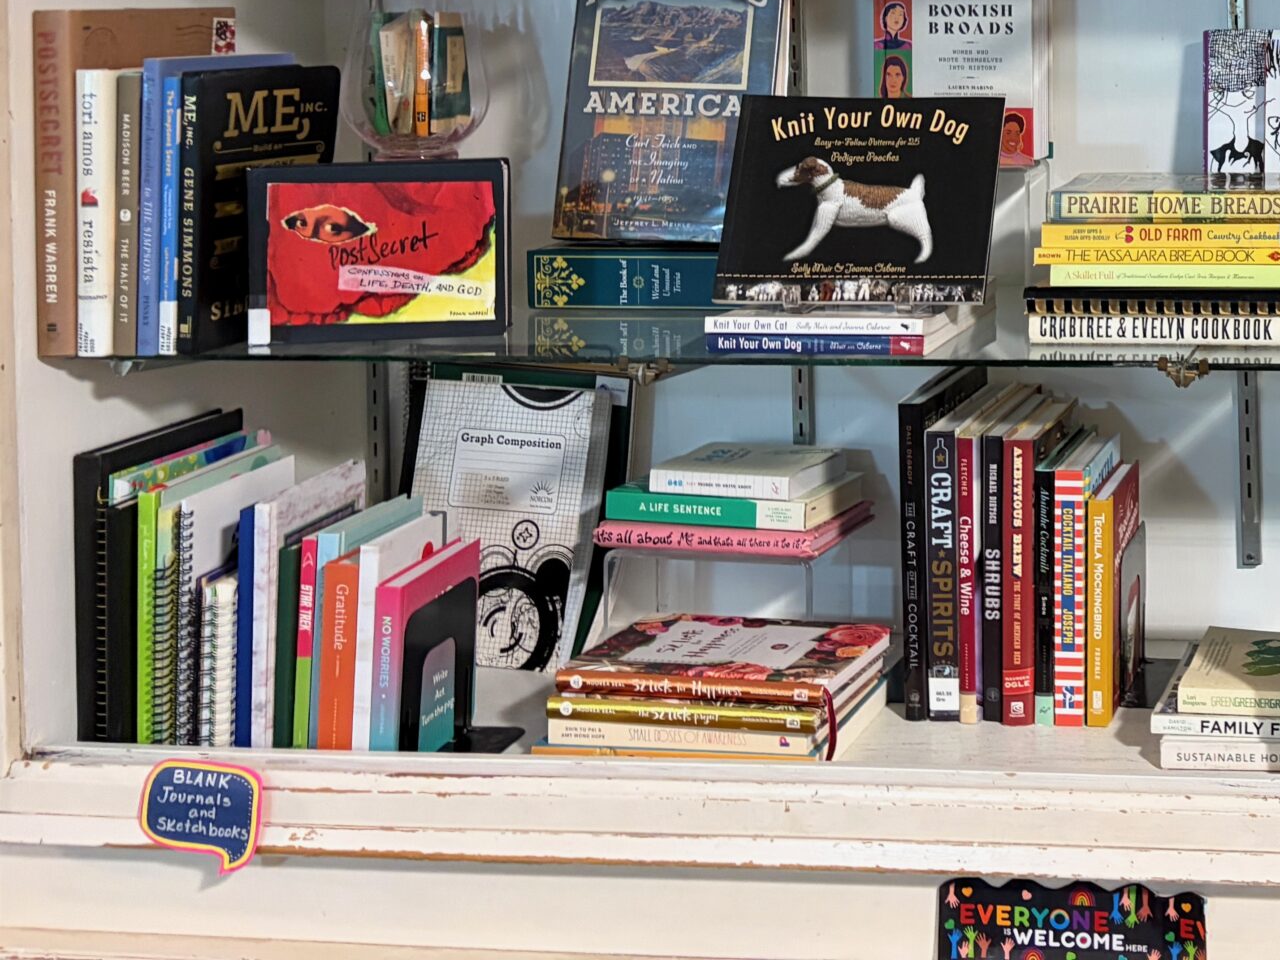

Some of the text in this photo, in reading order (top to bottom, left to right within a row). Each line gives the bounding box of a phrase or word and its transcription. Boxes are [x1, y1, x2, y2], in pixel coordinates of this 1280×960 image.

[928, 4, 1013, 18] BOOKISH
[928, 22, 1014, 35] BROADS
[223, 87, 328, 140] ME, INC.
[583, 91, 742, 117] AMERICA
[771, 104, 969, 145] Knit Your Own Dog
[122, 113, 131, 196] MADISON BEER
[1067, 197, 1139, 214] PRAIRIE
[1147, 197, 1202, 215] HOME
[182, 168, 194, 298] GENE SIMMONS
[1139, 228, 1203, 242] OLD FARM
[44, 190, 58, 304] FRANK WARREN
[1065, 249, 1255, 262] THE TASSAJARA BREAD BOOK
[457, 284, 482, 296] GOD
[1040, 316, 1272, 341] CRABTREE & EVELYN COOKBOOK
[461, 432, 562, 450] Graph Composition
[639, 501, 722, 516] A LIFE SENTENCE
[931, 472, 954, 657] CRAFT SPIRITS
[985, 548, 1000, 621] SHRUBS
[1093, 513, 1105, 640] TEQUILA MOCKINGBIRD
[334, 583, 349, 651] Gratitude
[1200, 720, 1263, 736] FAMILY
[1176, 752, 1256, 763] SUSTAINABLE
[173, 769, 231, 789] BLANK
[157, 786, 231, 807] Journals
[189, 807, 216, 819] and
[959, 904, 1110, 932] EVERYONE
[1013, 928, 1125, 952] WELCOME
